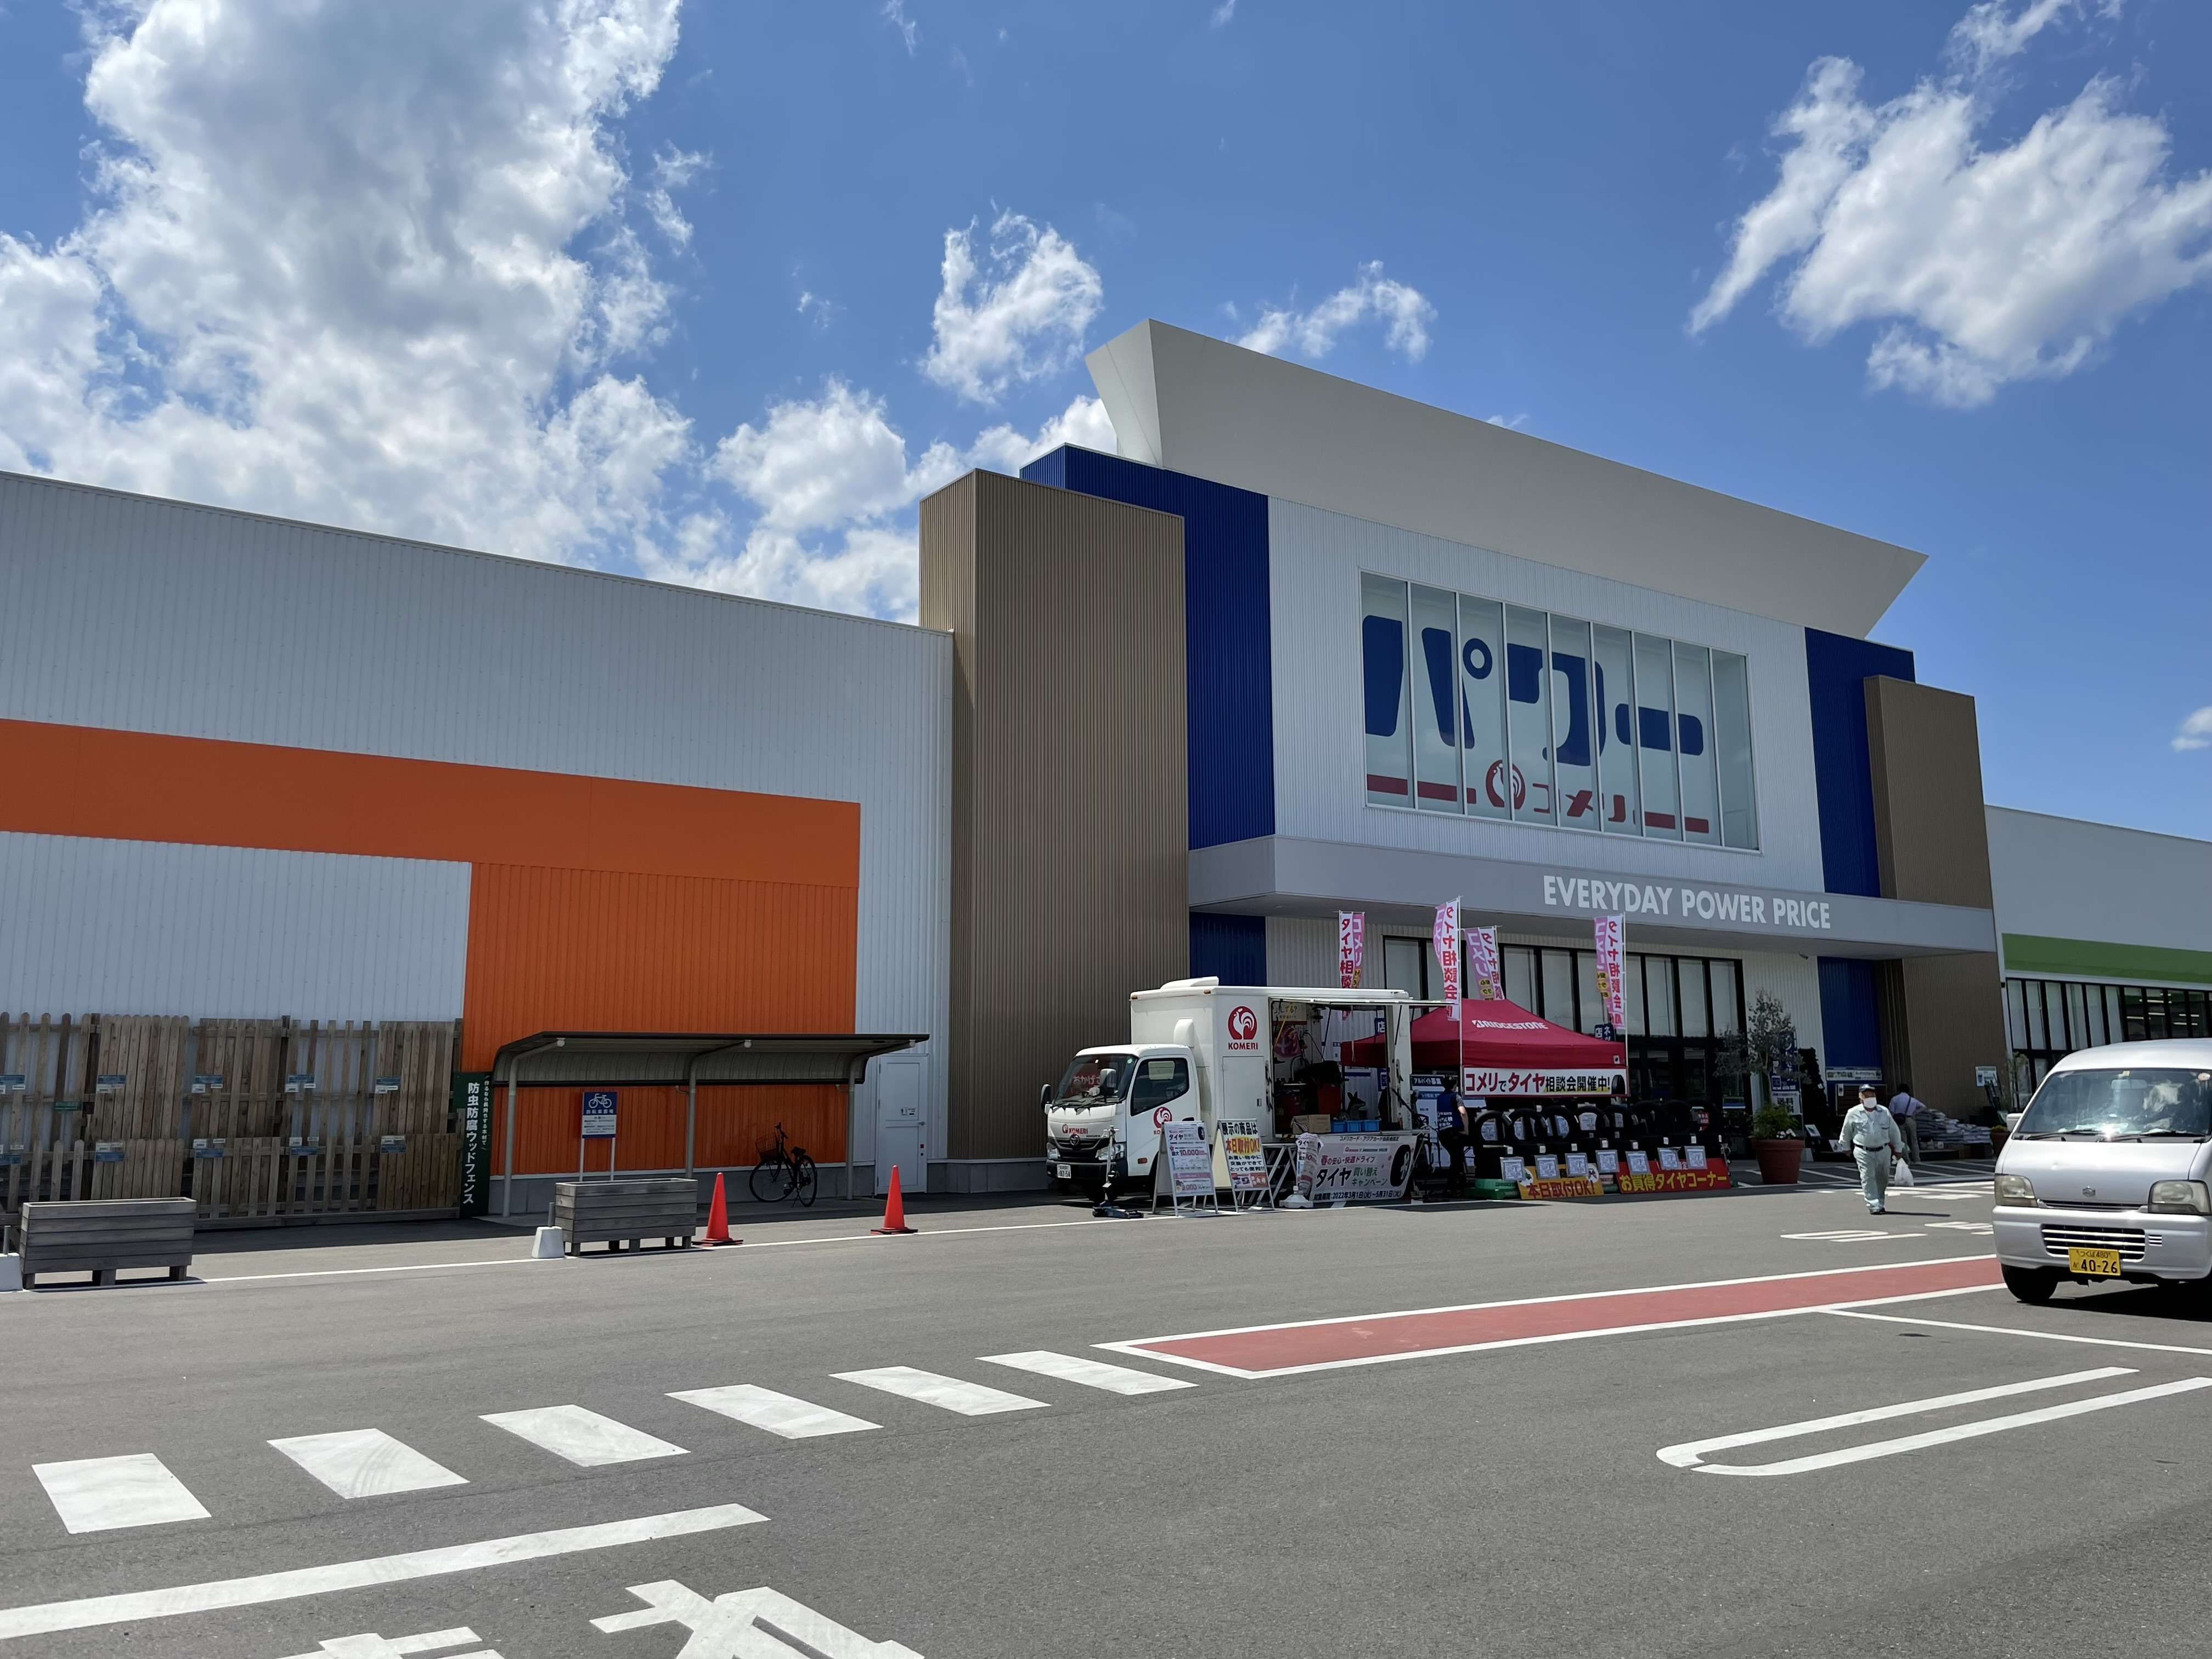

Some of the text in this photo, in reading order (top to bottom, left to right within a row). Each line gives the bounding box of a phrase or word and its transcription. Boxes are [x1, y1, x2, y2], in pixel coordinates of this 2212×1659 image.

[1362, 615, 1703, 766] パワー
[1532, 783, 1627, 823] コメリ
[1543, 875, 1831, 929] EVERYDAY POWER PRICE
[1353, 918, 1363, 967] コメリ
[1471, 1019, 1549, 1029] BRIDGESTONE
[1221, 1122, 1259, 1135] 展示の商品は
[462, 1082, 480, 1205] 防虫防腐ウッドフェンス
[1316, 1167, 1352, 1188] タイヤ
[1619, 1171, 1727, 1192] お買得タイヤコーナー
[1526, 1180, 1595, 1199] 本日取付OK!
[2081, 1259, 2118, 1273] 40-26
